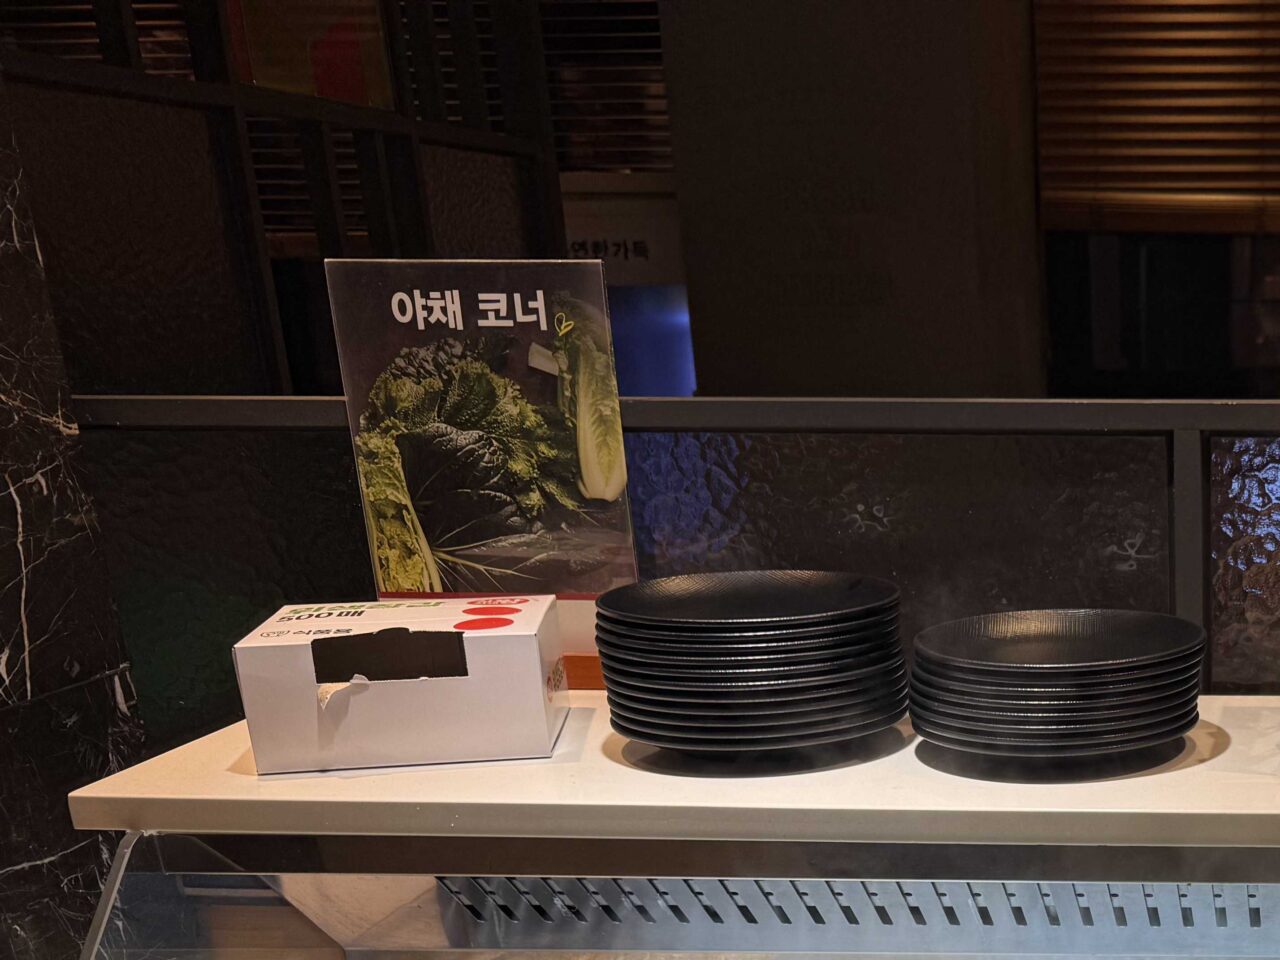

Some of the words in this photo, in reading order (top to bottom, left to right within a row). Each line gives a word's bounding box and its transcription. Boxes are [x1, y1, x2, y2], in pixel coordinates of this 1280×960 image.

[391, 289, 464, 331] 야채
[477, 289, 548, 331] 코너
[276, 609, 365, 622] 500매
